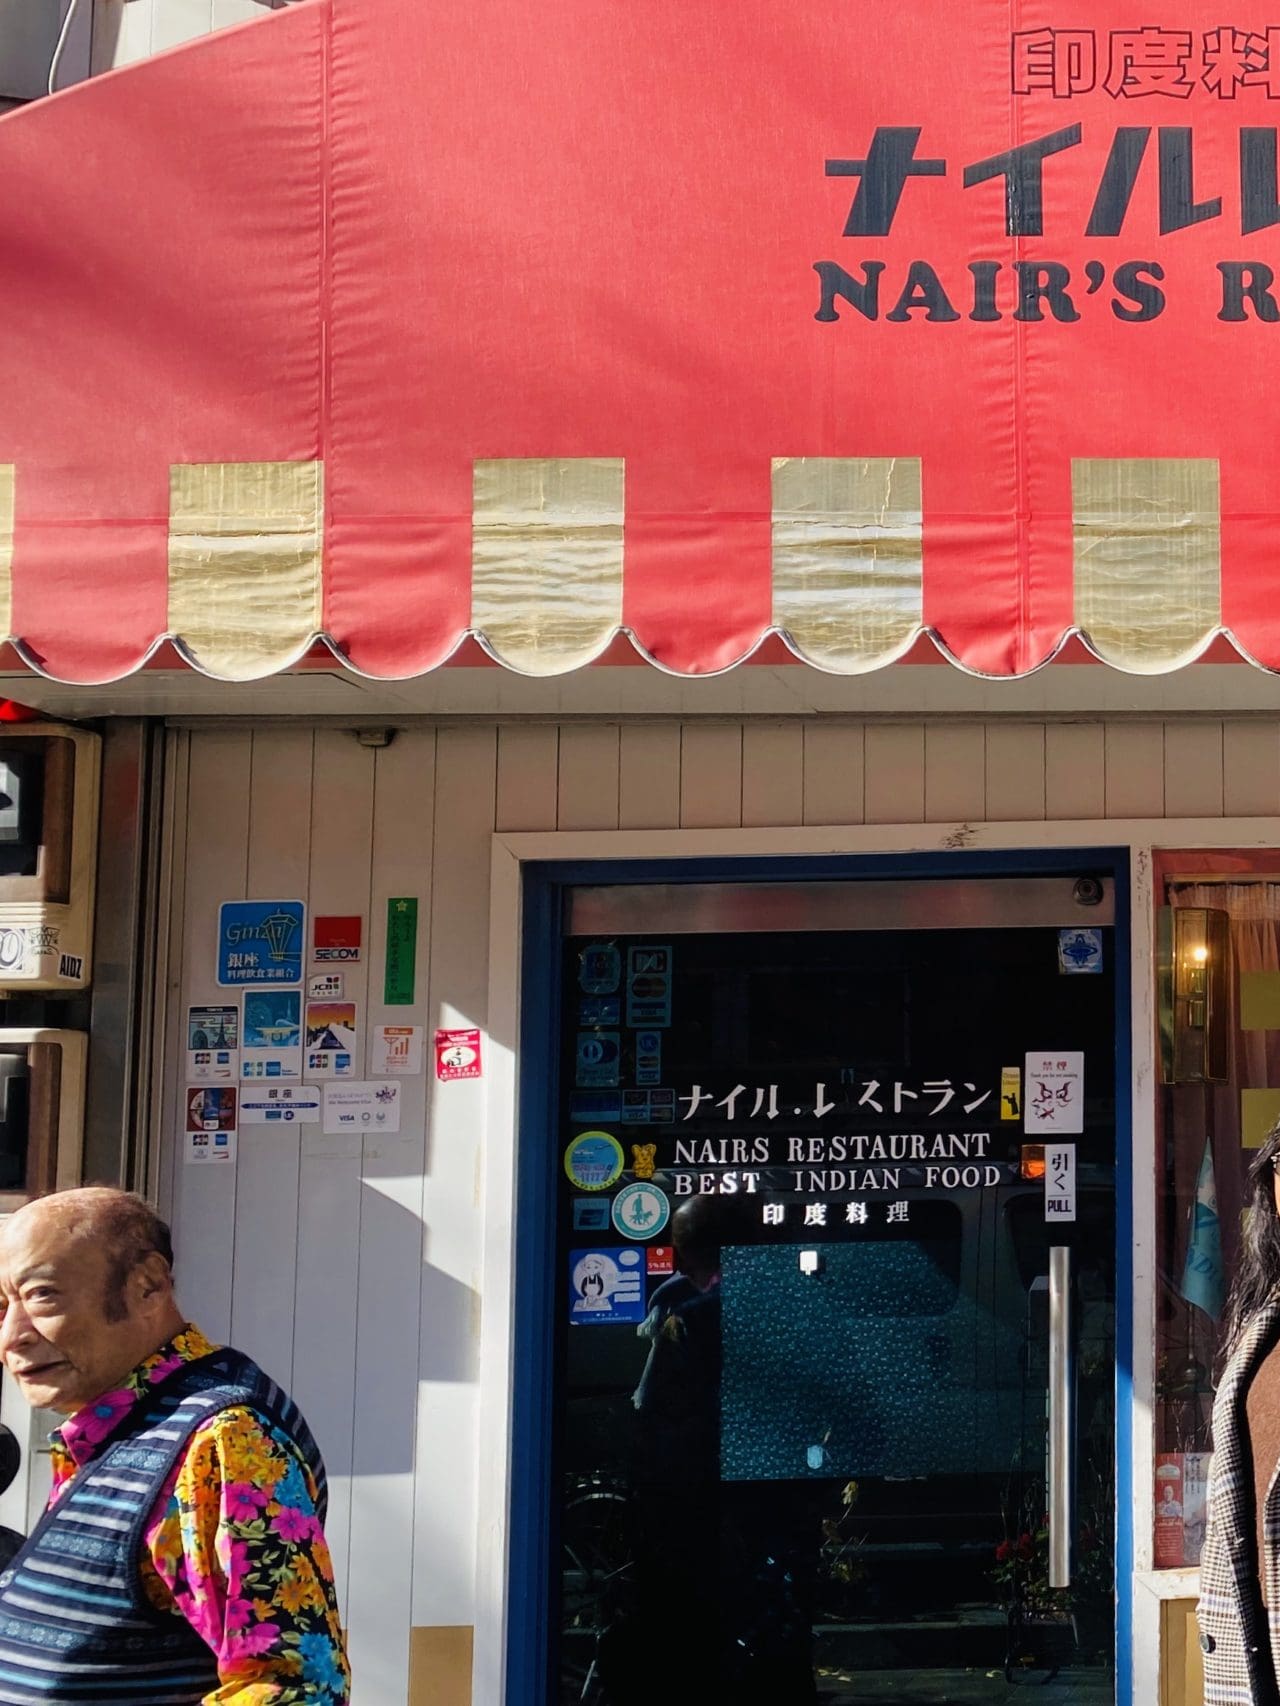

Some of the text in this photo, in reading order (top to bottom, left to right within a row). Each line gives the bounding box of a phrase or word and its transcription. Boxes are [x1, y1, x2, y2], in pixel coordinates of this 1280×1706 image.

[814, 261, 1165, 323] NAIR'S
[60, 954, 82, 979] AIDZ
[315, 948, 359, 960] SECOM
[673, 1133, 991, 1164] NAIRS RESTAURANT
[674, 1166, 1001, 1195] BEST INDIAN FOOD
[1051, 1153, 1068, 1191] 引く
[762, 1201, 910, 1226] 印度料理
[1047, 1199, 1073, 1213] PULL
